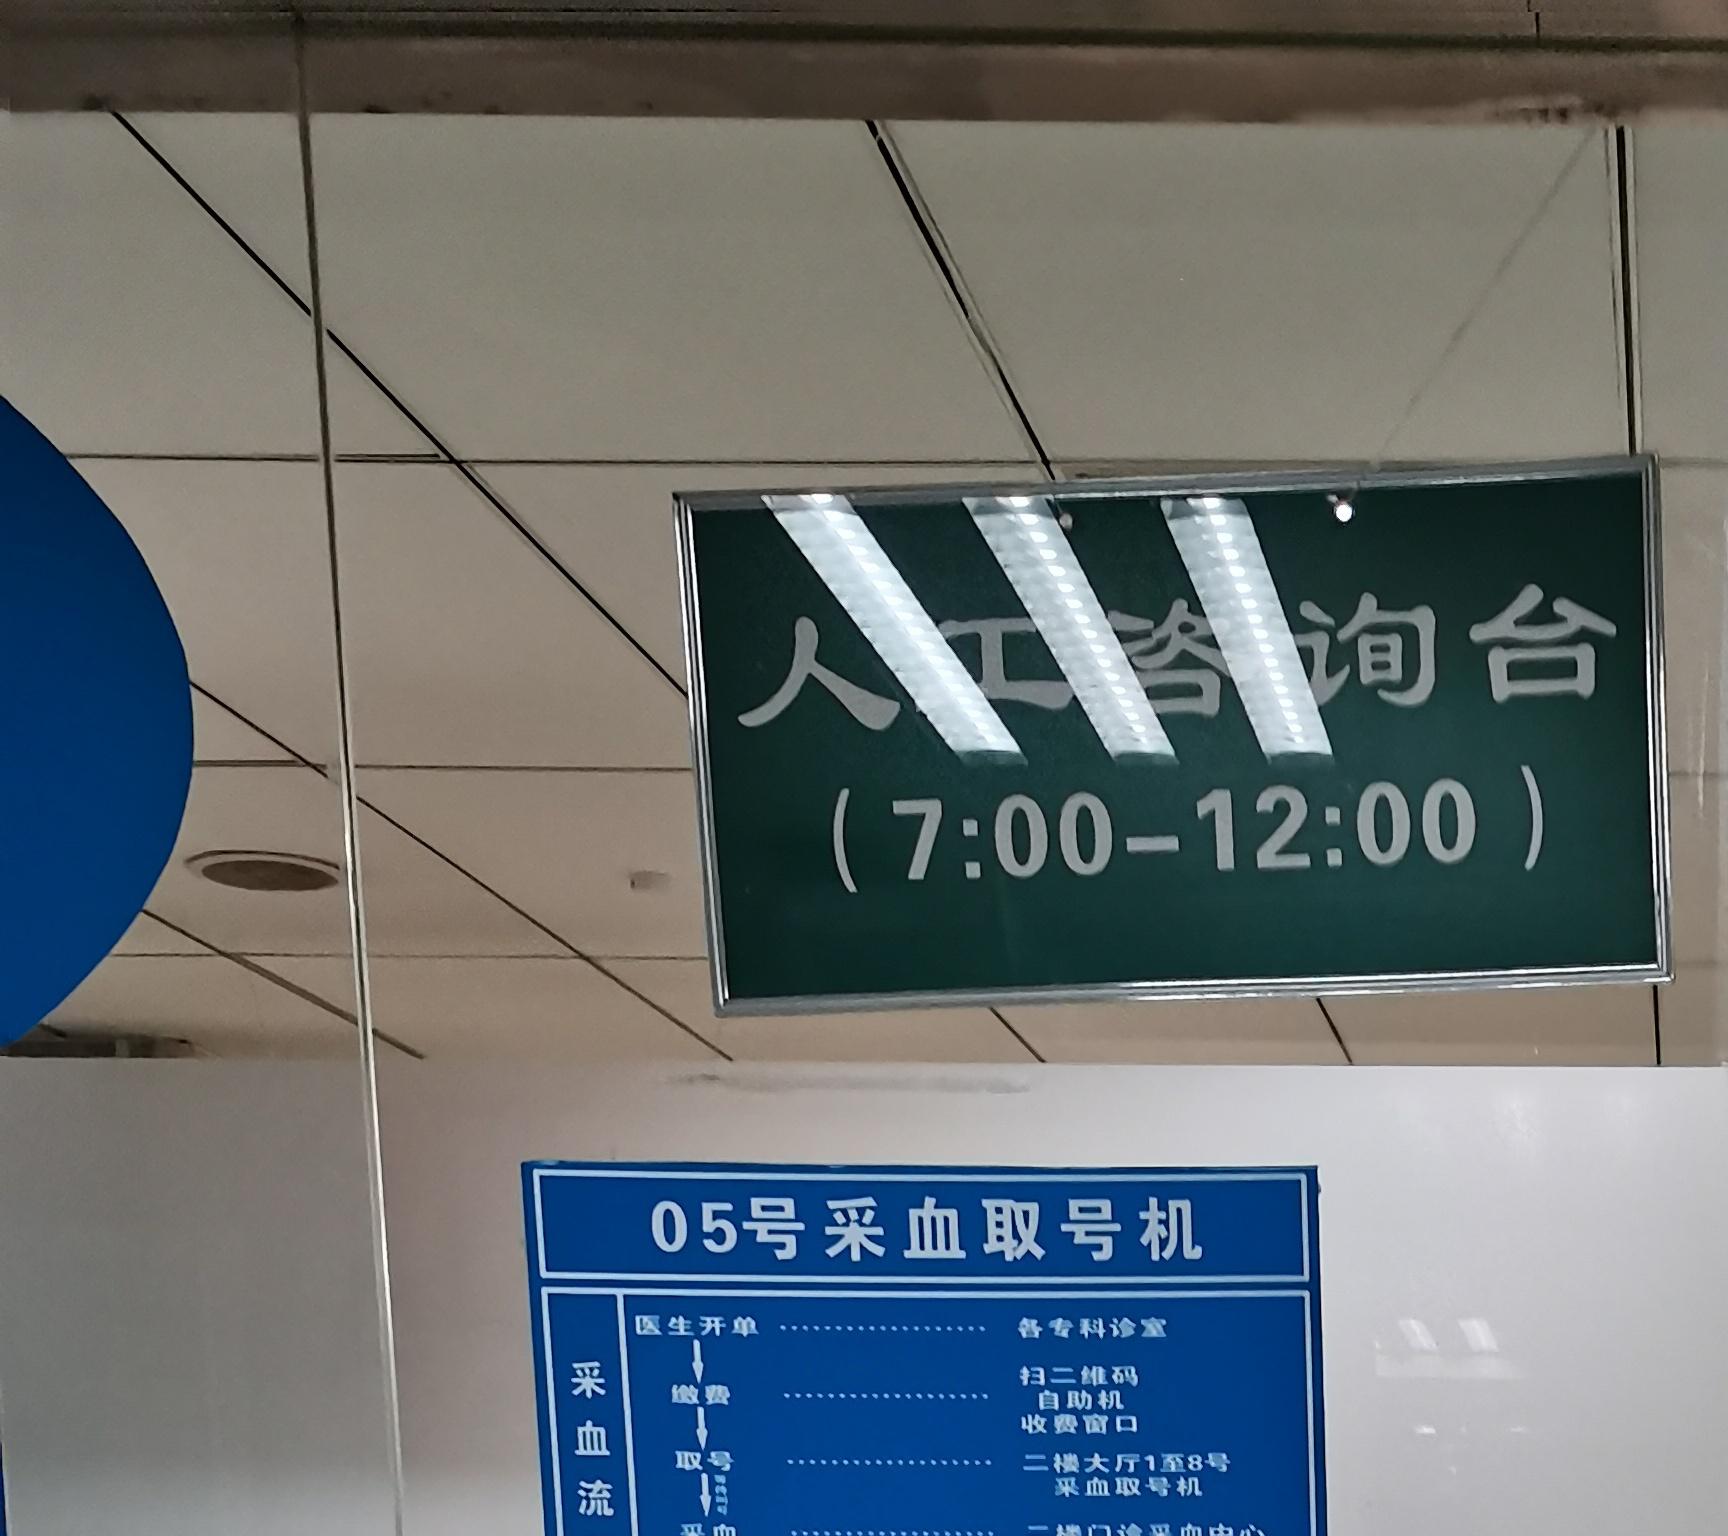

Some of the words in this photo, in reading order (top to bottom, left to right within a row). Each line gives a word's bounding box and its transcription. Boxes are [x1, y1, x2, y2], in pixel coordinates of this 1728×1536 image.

[738, 583, 1617, 731] 人工咨询台
[652, 1196, 1202, 1261] 05号采血取号机
[635, 1315, 758, 1336] 医生开单
[1018, 1317, 1166, 1339] 各专科诊室
[1020, 1366, 1138, 1386] 扫二维码
[672, 1385, 730, 1405] 缴费
[1039, 1390, 1124, 1410] 自助机
[1022, 1414, 1137, 1434] 收费窗口
[675, 1451, 733, 1471] 取号
[1023, 1453, 1230, 1473] 二楼大厅1至8号
[1055, 1476, 1202, 1497] 采血取号机
